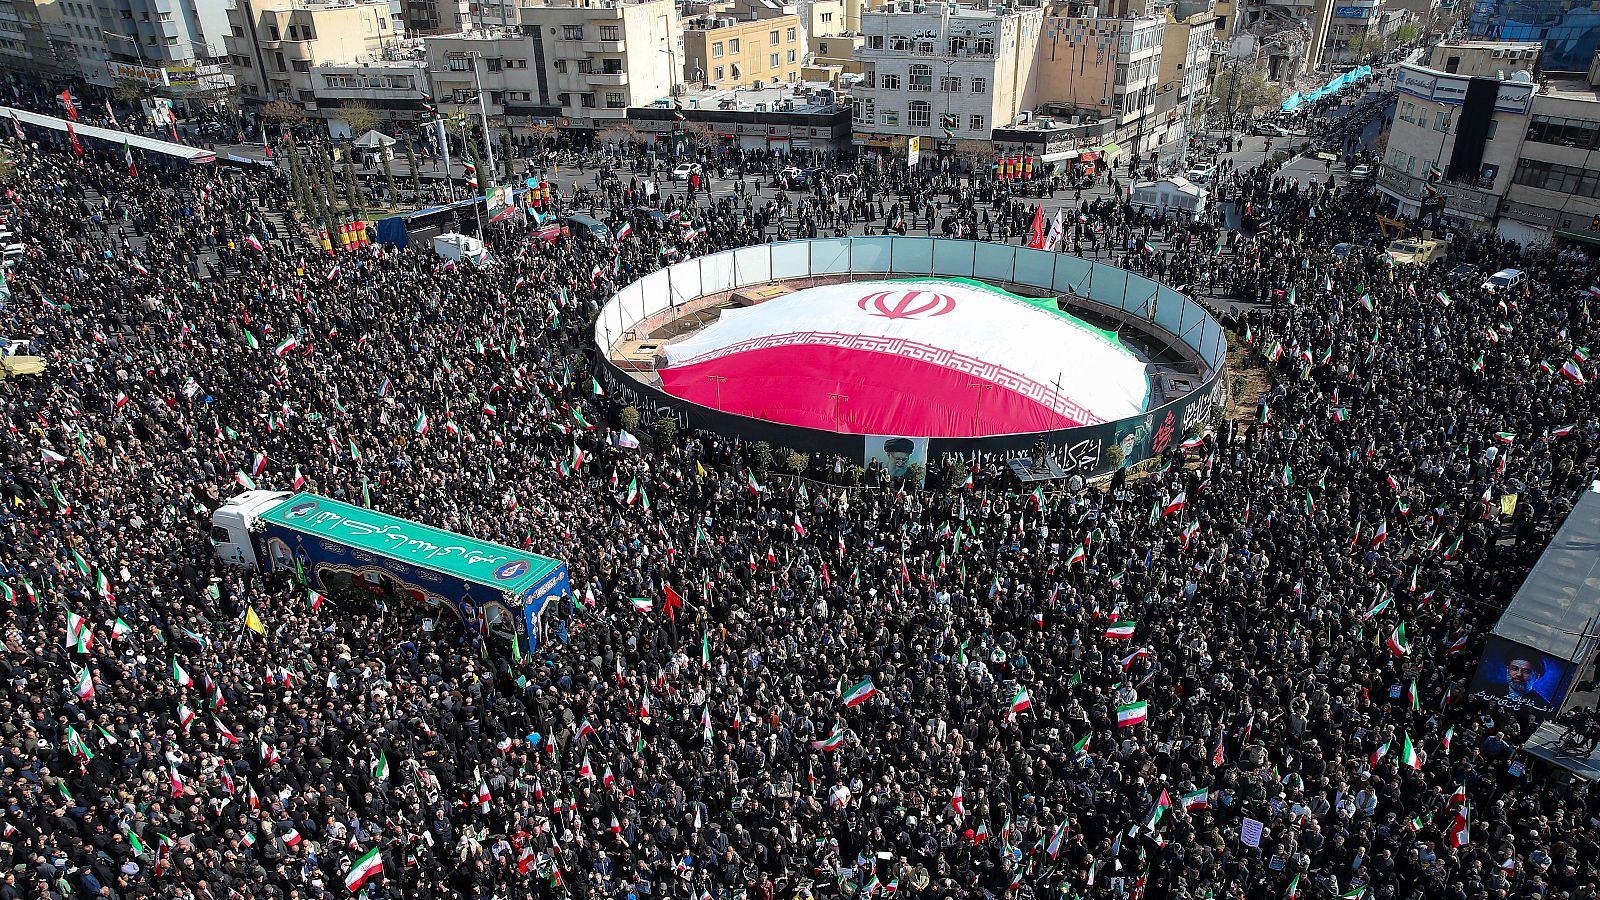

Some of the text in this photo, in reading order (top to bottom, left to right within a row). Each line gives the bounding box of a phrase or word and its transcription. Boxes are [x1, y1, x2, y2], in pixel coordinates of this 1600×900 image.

[304, 510, 341, 527] الله
[328, 517, 401, 535] اکبر
[463, 549, 508, 565] رهبر
